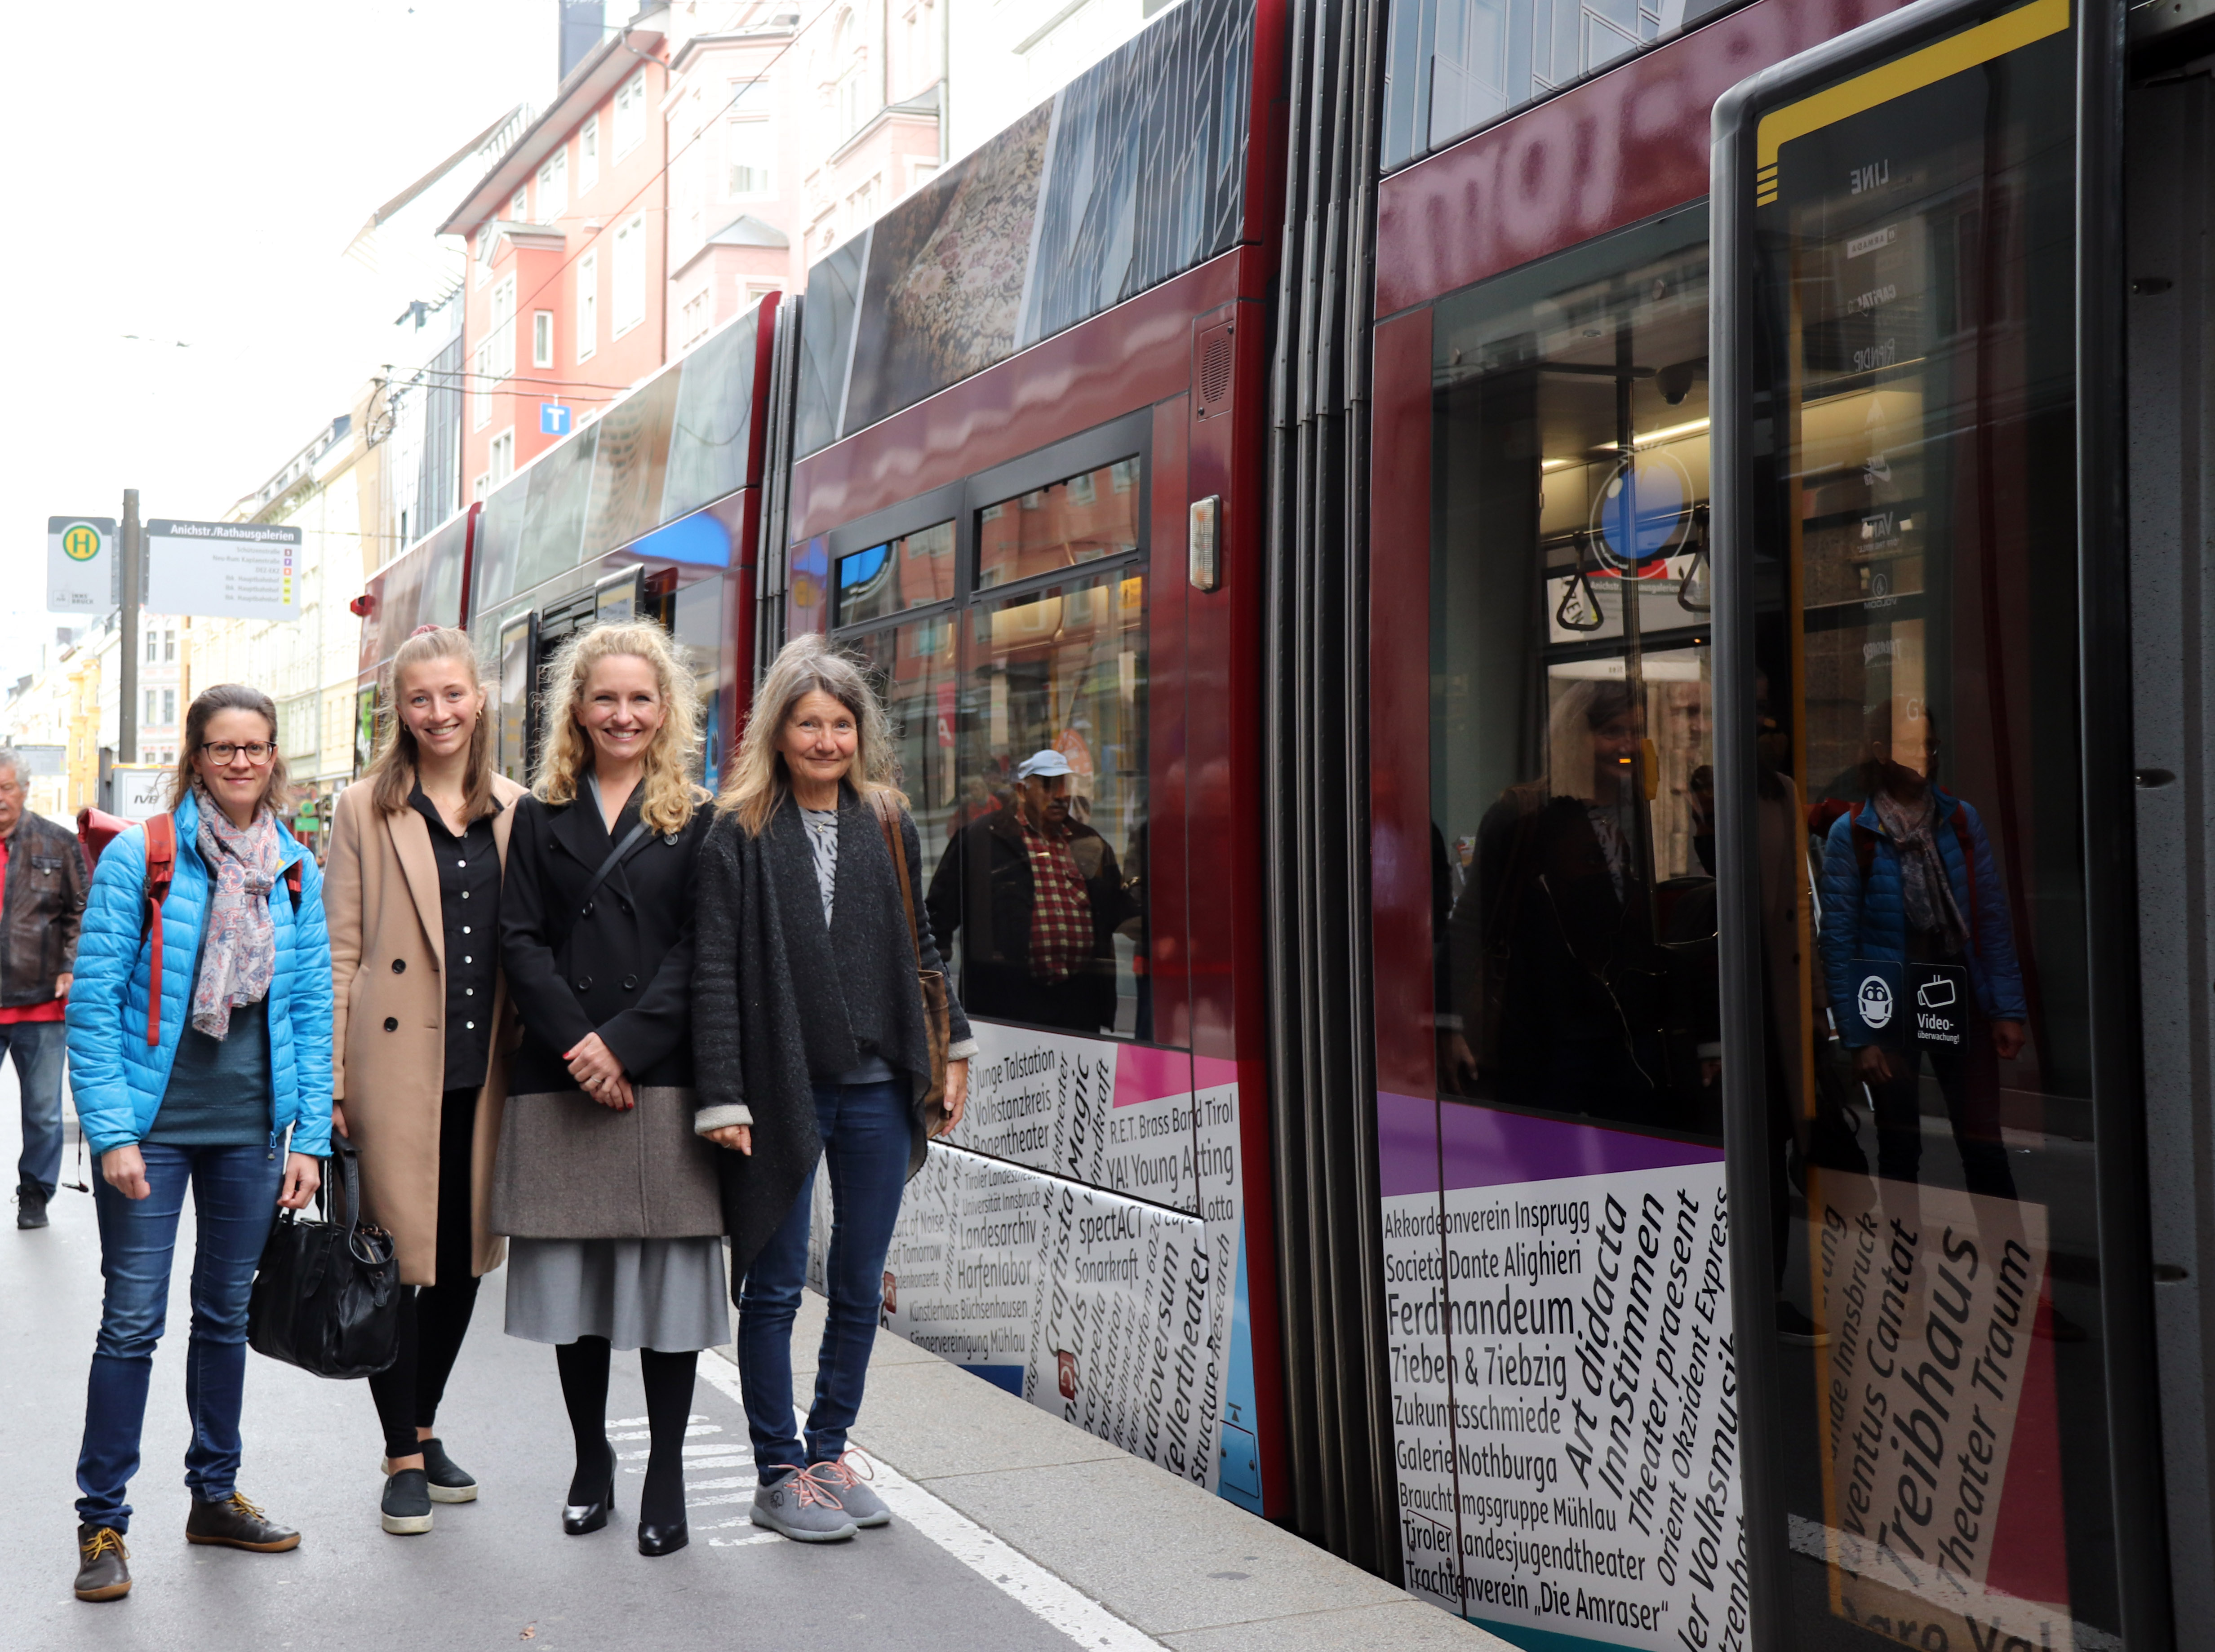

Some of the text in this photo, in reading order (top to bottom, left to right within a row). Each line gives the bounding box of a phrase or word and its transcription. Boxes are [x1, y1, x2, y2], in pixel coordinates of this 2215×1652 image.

[547, 408, 564, 430] T
[73, 533, 90, 554] H
[170, 523, 294, 542] Anichstr./Rathausgalerien
[134, 795, 159, 804] IVB
[1917, 1013, 1954, 1031] Video-
[1917, 1030, 1960, 1045] überwachung!
[976, 1045, 1055, 1097] Junge Talstation
[975, 1082, 1052, 1127] Volkstanzkreis
[1068, 1054, 1091, 1180] Magic
[1110, 1093, 1233, 1144] R.E.T. Brass Band Tirol
[1106, 1153, 1128, 1190] YA!
[1131, 1153, 1178, 1193] Young
[910, 1209, 919, 1243] of
[921, 1207, 944, 1234] Noise
[963, 1185, 1040, 1217] Universität Innsbruck
[1201, 1195, 1233, 1223] Lotta
[1385, 1200, 1590, 1239] Akkordeonverein Insprugg
[960, 1211, 1036, 1250] Landesarchiv
[1026, 1051, 1068, 1405] eitgenössisches Muiktheater
[1080, 1206, 1144, 1255] spectACT
[902, 1244, 941, 1265] Tomorrow
[958, 1251, 1032, 1298] Harfenlabor
[1075, 1248, 1139, 1289] Sonarkraft
[1386, 1238, 1581, 1287] Società Dante Alighieri
[910, 1298, 959, 1322] Künstlerhaus
[961, 1294, 1028, 1320] Büchsenhausen
[1388, 1283, 1574, 1335] Ferdinandeum
[1833, 1212, 1878, 1378] Innsbruck
[1866, 1218, 1918, 1379] Cantat
[990, 1326, 1025, 1353] Mühlau
[1083, 1290, 1105, 1434] ocappella
[1144, 1241, 1179, 1462] udioversum
[1191, 1233, 1230, 1488] Structure Research
[1565, 1192, 1627, 1491] Art didacta
[1598, 1192, 1665, 1501] InnStimmen
[1629, 1188, 1699, 1537] Theater praesent
[1098, 1291, 1123, 1441] orkstation
[1390, 1342, 1567, 1401] 7ieben & 7iebzig
[1657, 1186, 1728, 1587] Orient Okzident Express
[1394, 1392, 1561, 1434] Zukuntsschmiede
[1875, 1225, 1979, 1589] Treibhaus
[1936, 1239, 2031, 1597] Theater Traum
[1397, 1437, 1557, 1493] Galerie Nothburga
[1399, 1482, 1617, 1532] Brauchtmgsgruppe Mühlau
[1403, 1515, 1452, 1553] Tiroler
[1406, 1559, 1529, 1610] Trachtenverein
